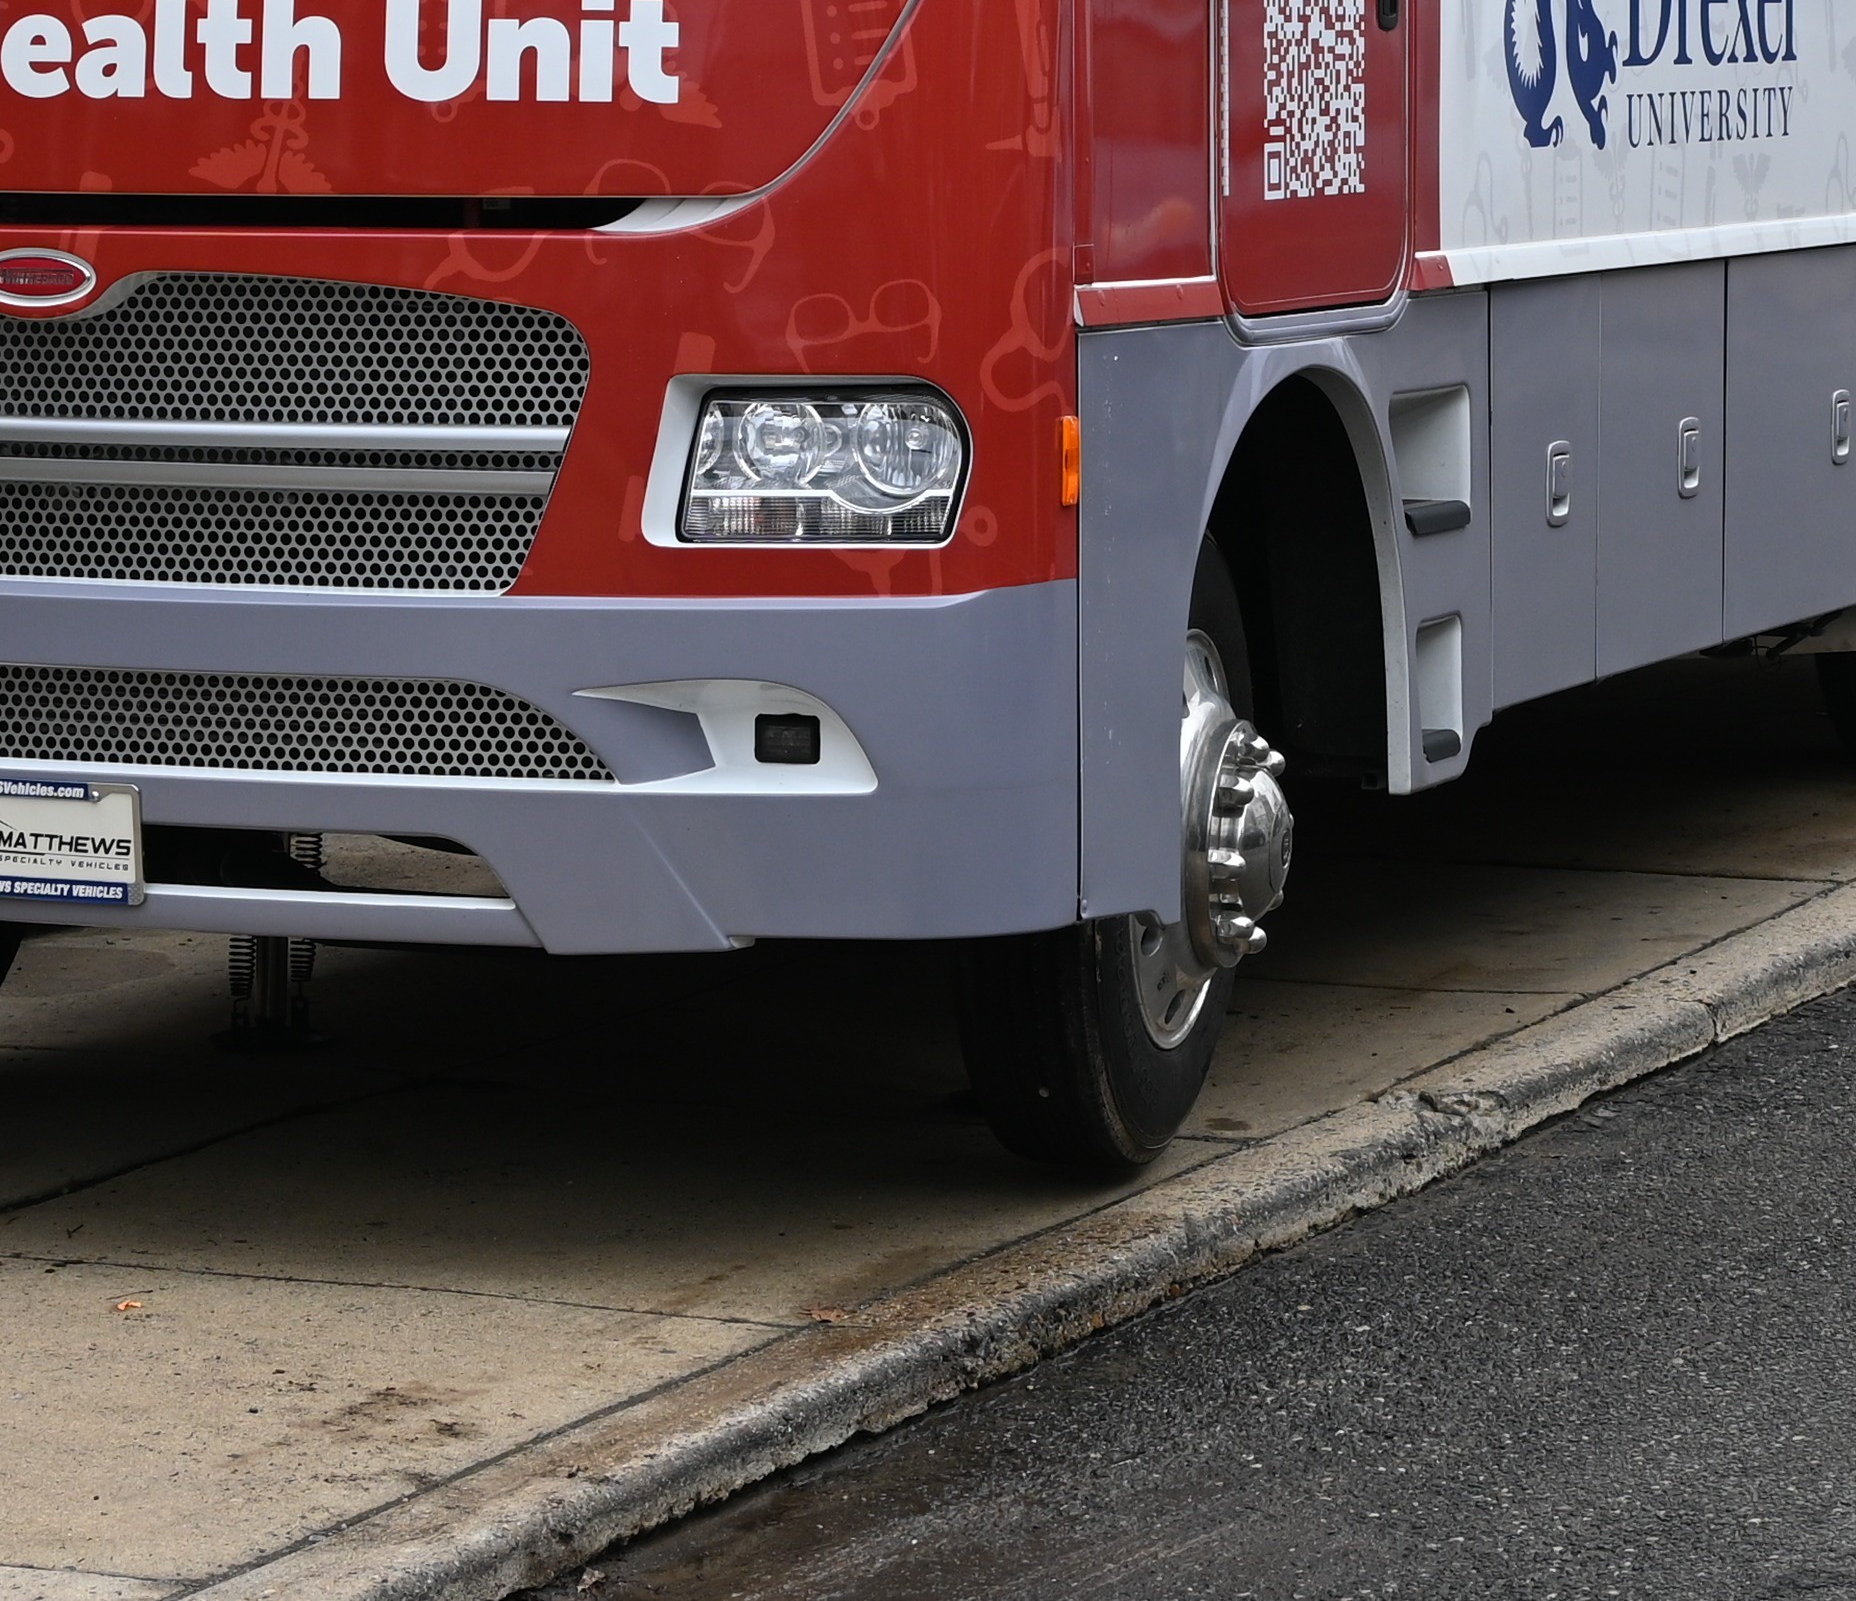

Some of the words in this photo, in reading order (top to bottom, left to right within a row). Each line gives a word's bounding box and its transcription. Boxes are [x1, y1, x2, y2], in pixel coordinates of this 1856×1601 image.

[1626, 86, 1793, 149] UNIVERSITY
[70, 860, 130, 872] VEHICLES
[13, 881, 71, 896] SPECIALTY
[72, 885, 124, 899] VEHICLES
